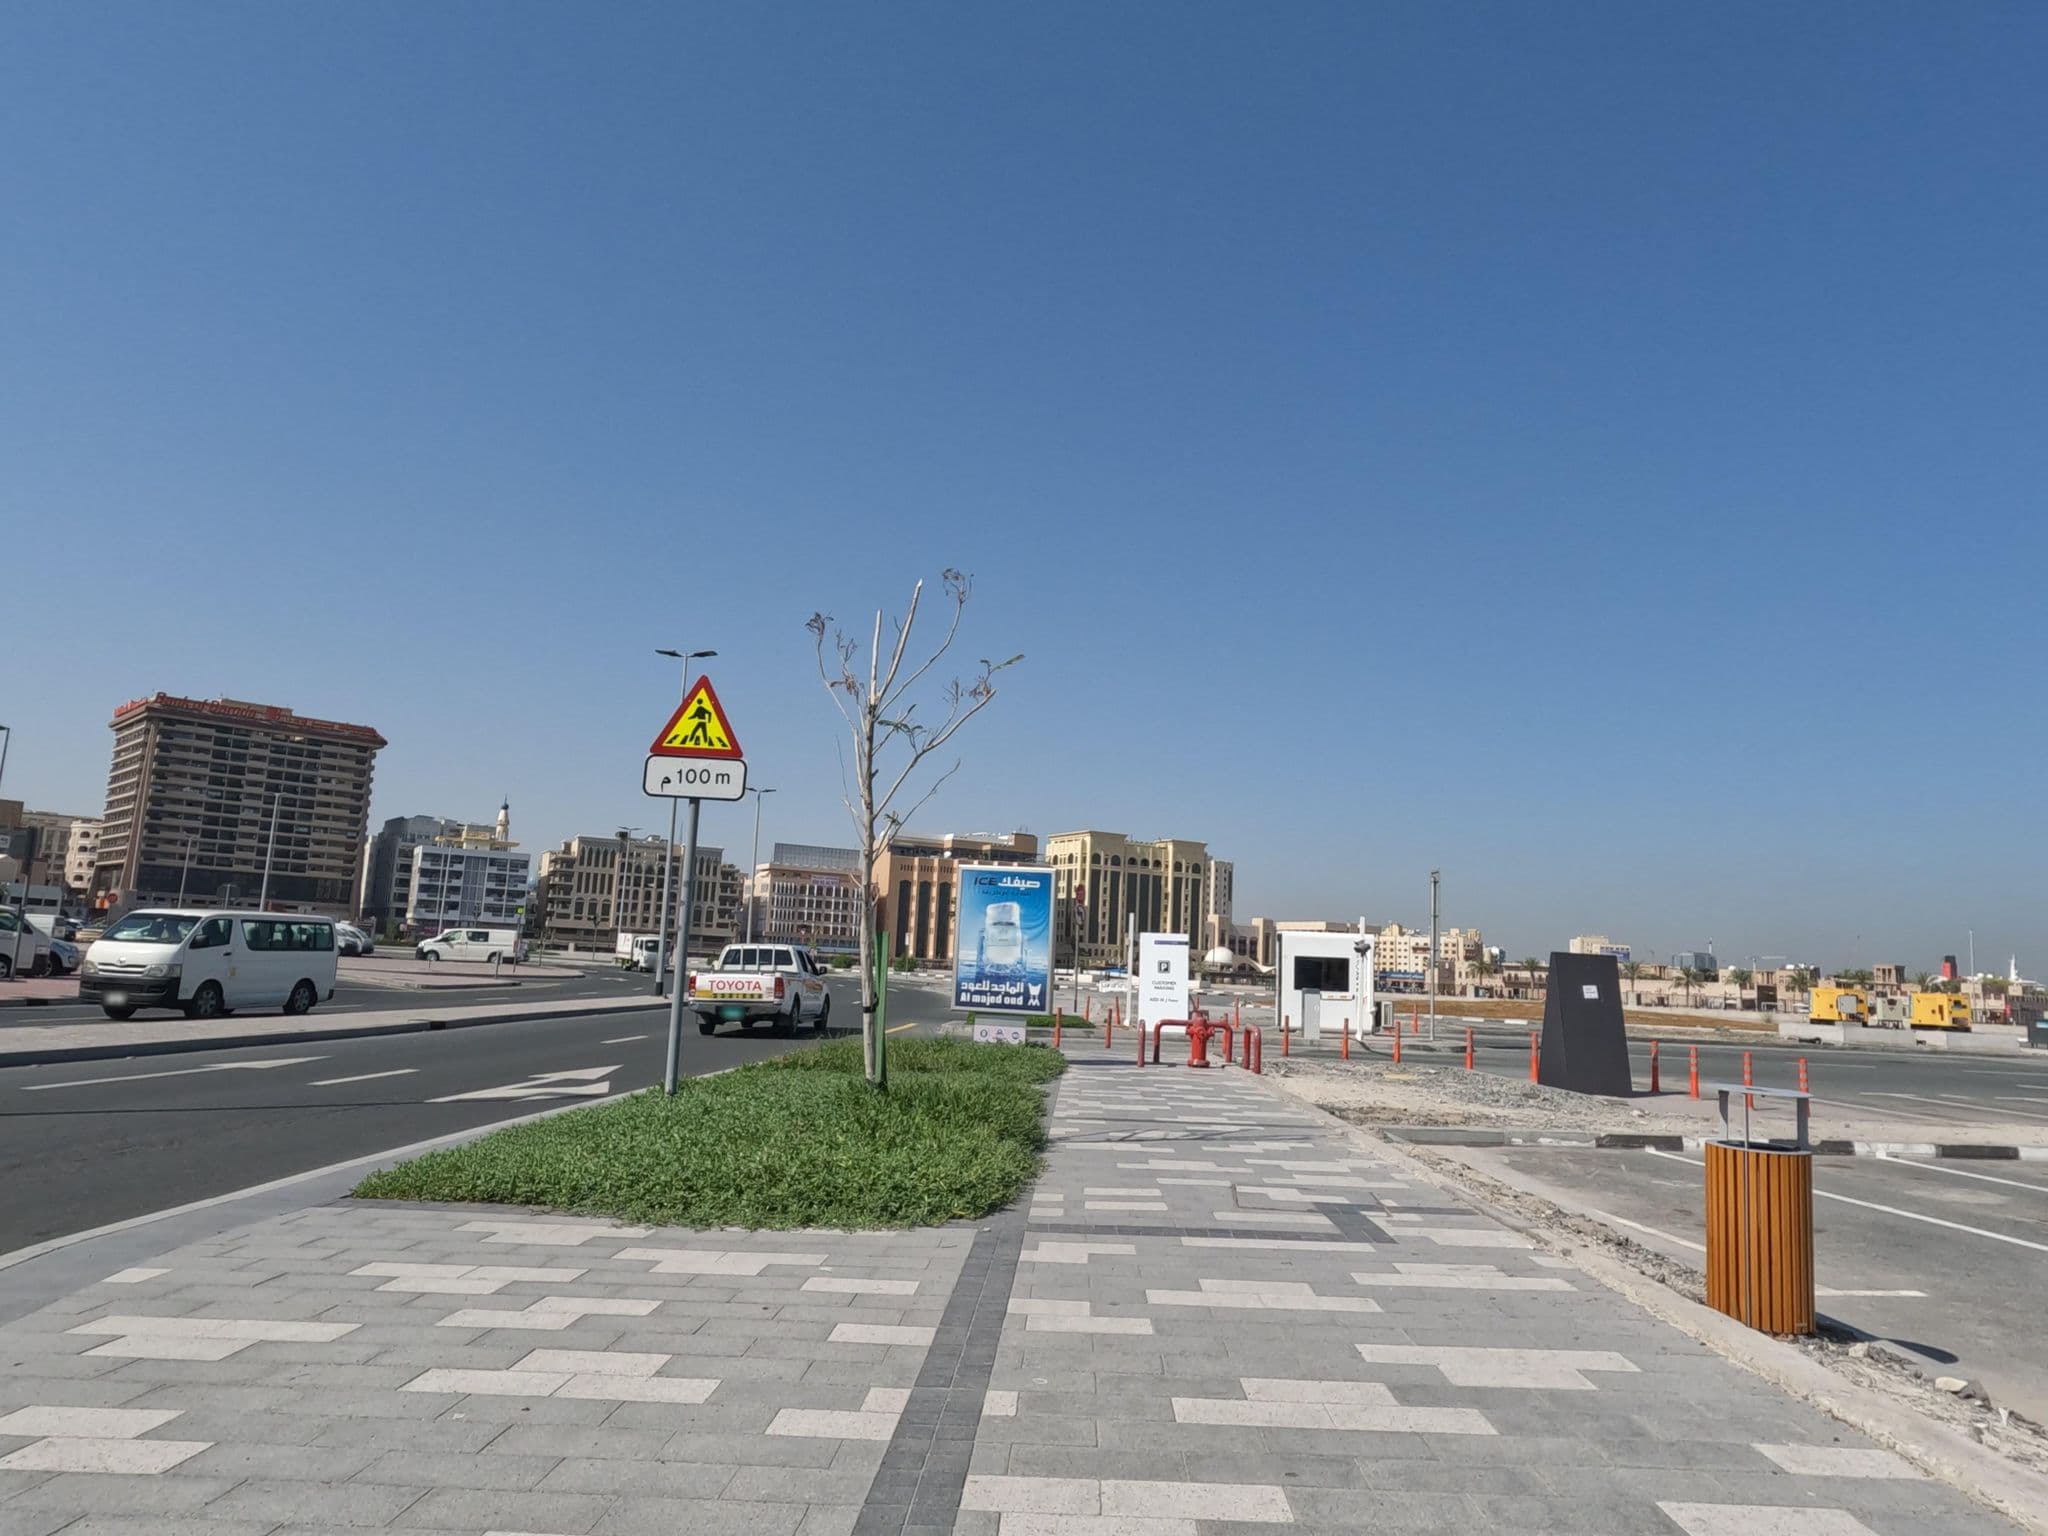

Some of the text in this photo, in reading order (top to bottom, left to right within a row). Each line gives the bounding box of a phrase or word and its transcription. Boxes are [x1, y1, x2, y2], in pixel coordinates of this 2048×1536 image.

[677, 768, 730, 784] 100 m
[974, 876, 997, 886] ICE
[709, 979, 762, 992] TOYOTA
[960, 980, 1024, 994] الماجد للعود
[960, 991, 1023, 1006] Al majed oud
